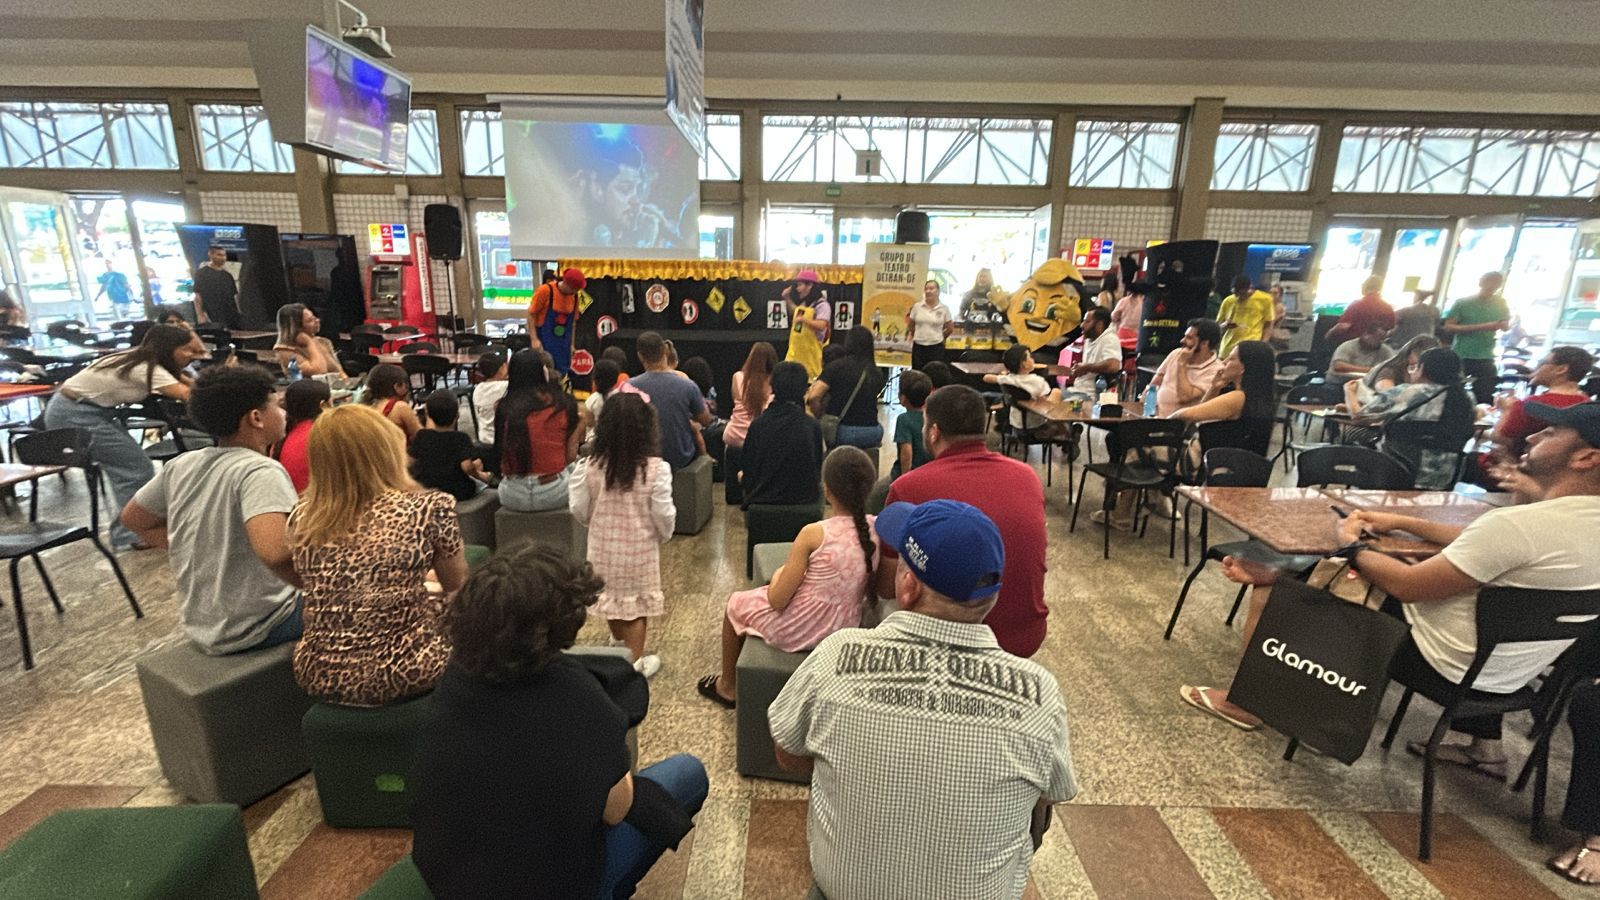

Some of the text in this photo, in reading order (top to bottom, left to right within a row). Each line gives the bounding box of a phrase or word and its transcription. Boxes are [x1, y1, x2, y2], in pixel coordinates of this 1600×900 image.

[880, 252, 915, 263] GRUPO DE
[884, 262, 910, 273] TEATRO
[876, 272, 916, 284] DETRAN-DF
[1262, 638, 1367, 696] Glamour
[836, 643, 1041, 706] ORIGINAL QUALITY
